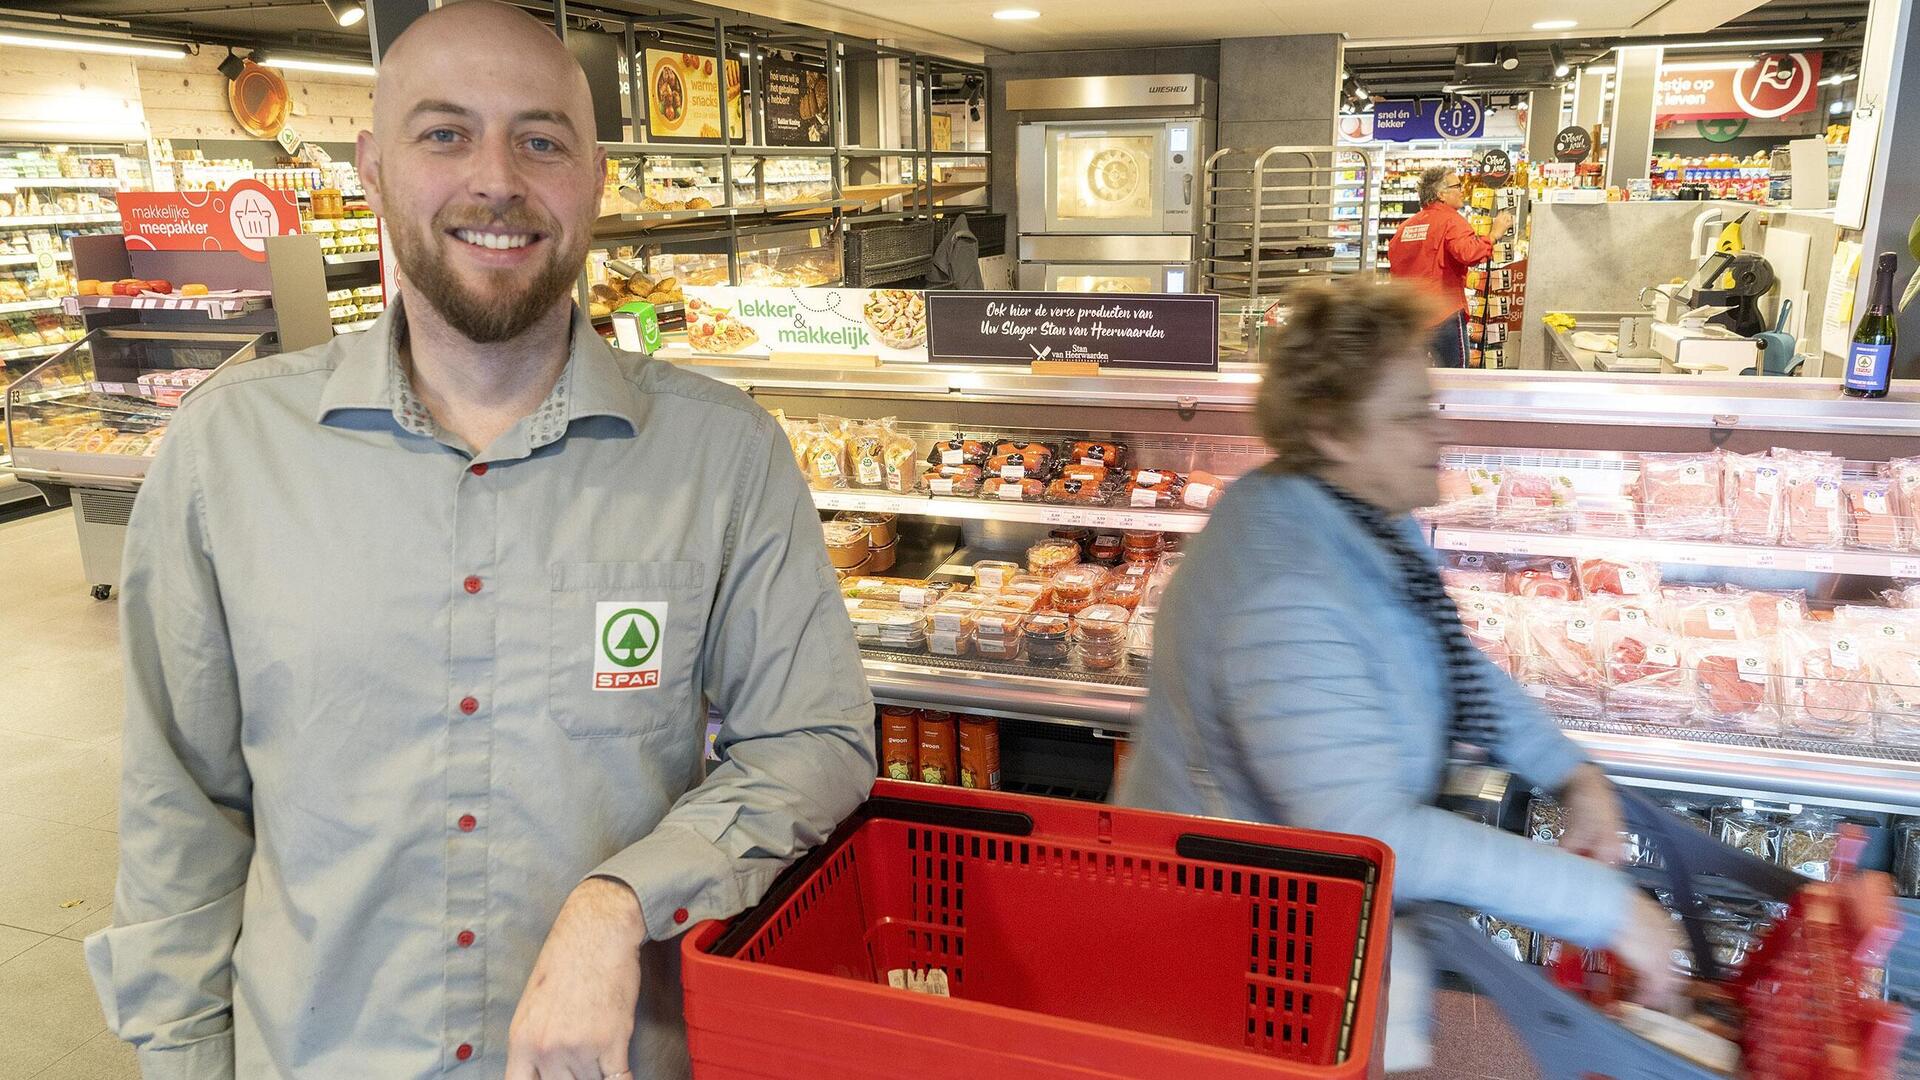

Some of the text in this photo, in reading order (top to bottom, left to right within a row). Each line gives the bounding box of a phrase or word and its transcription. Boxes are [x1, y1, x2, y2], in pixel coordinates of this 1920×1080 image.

[1693, 80, 1715, 93] op
[692, 96, 718, 107] snacks
[1665, 92, 1706, 106] leven
[1378, 110, 1397, 119] snel
[1377, 120, 1406, 129] lekker
[132, 204, 190, 222] makkelijke
[140, 220, 209, 238] meepakker
[738, 299, 807, 329] lekker &
[986, 302, 1153, 323] Ook hier de verse producten van
[778, 326, 870, 350] makkelijk
[980, 320, 1165, 341] Uw Slager Stan van Heerwaarden
[1064, 350, 1109, 360] Heerwaarden
[1072, 344, 1088, 353] Stan
[597, 671, 657, 687] SPAR
